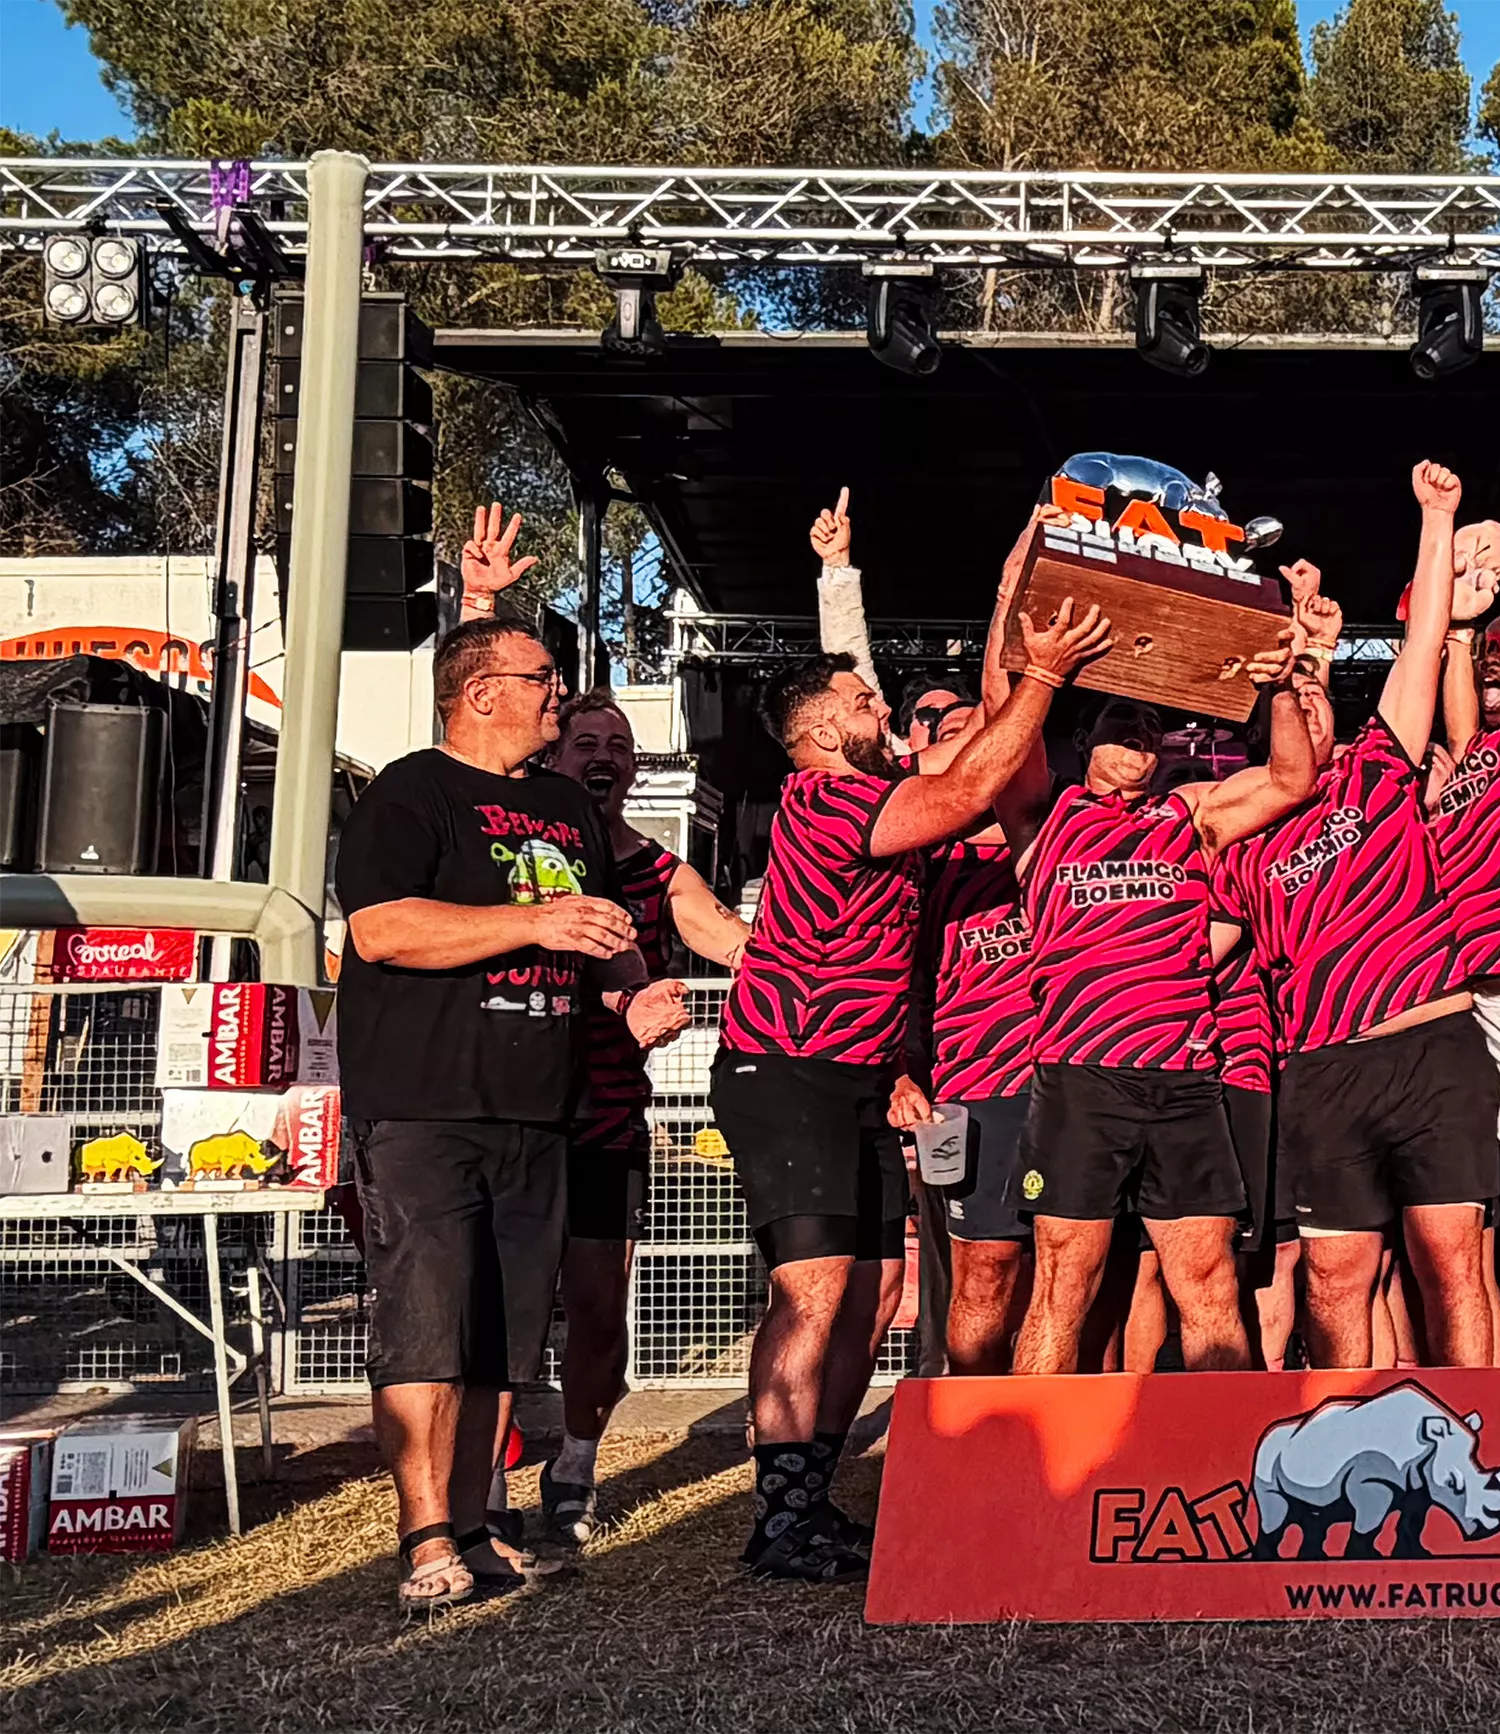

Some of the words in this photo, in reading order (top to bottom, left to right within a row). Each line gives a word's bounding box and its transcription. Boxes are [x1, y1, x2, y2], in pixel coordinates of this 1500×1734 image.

[1440, 775, 1489, 816] EMIO
[1056, 860, 1187, 885] FLAMINGO
[1072, 880, 1175, 908] BOEMIO
[214, 984, 243, 1085] AMBAR
[268, 986, 287, 1083] AMBAR
[299, 1088, 328, 1186] AMBAR
[50, 1503, 172, 1535] AMBAR
[1090, 1479, 1254, 1562] FAT
